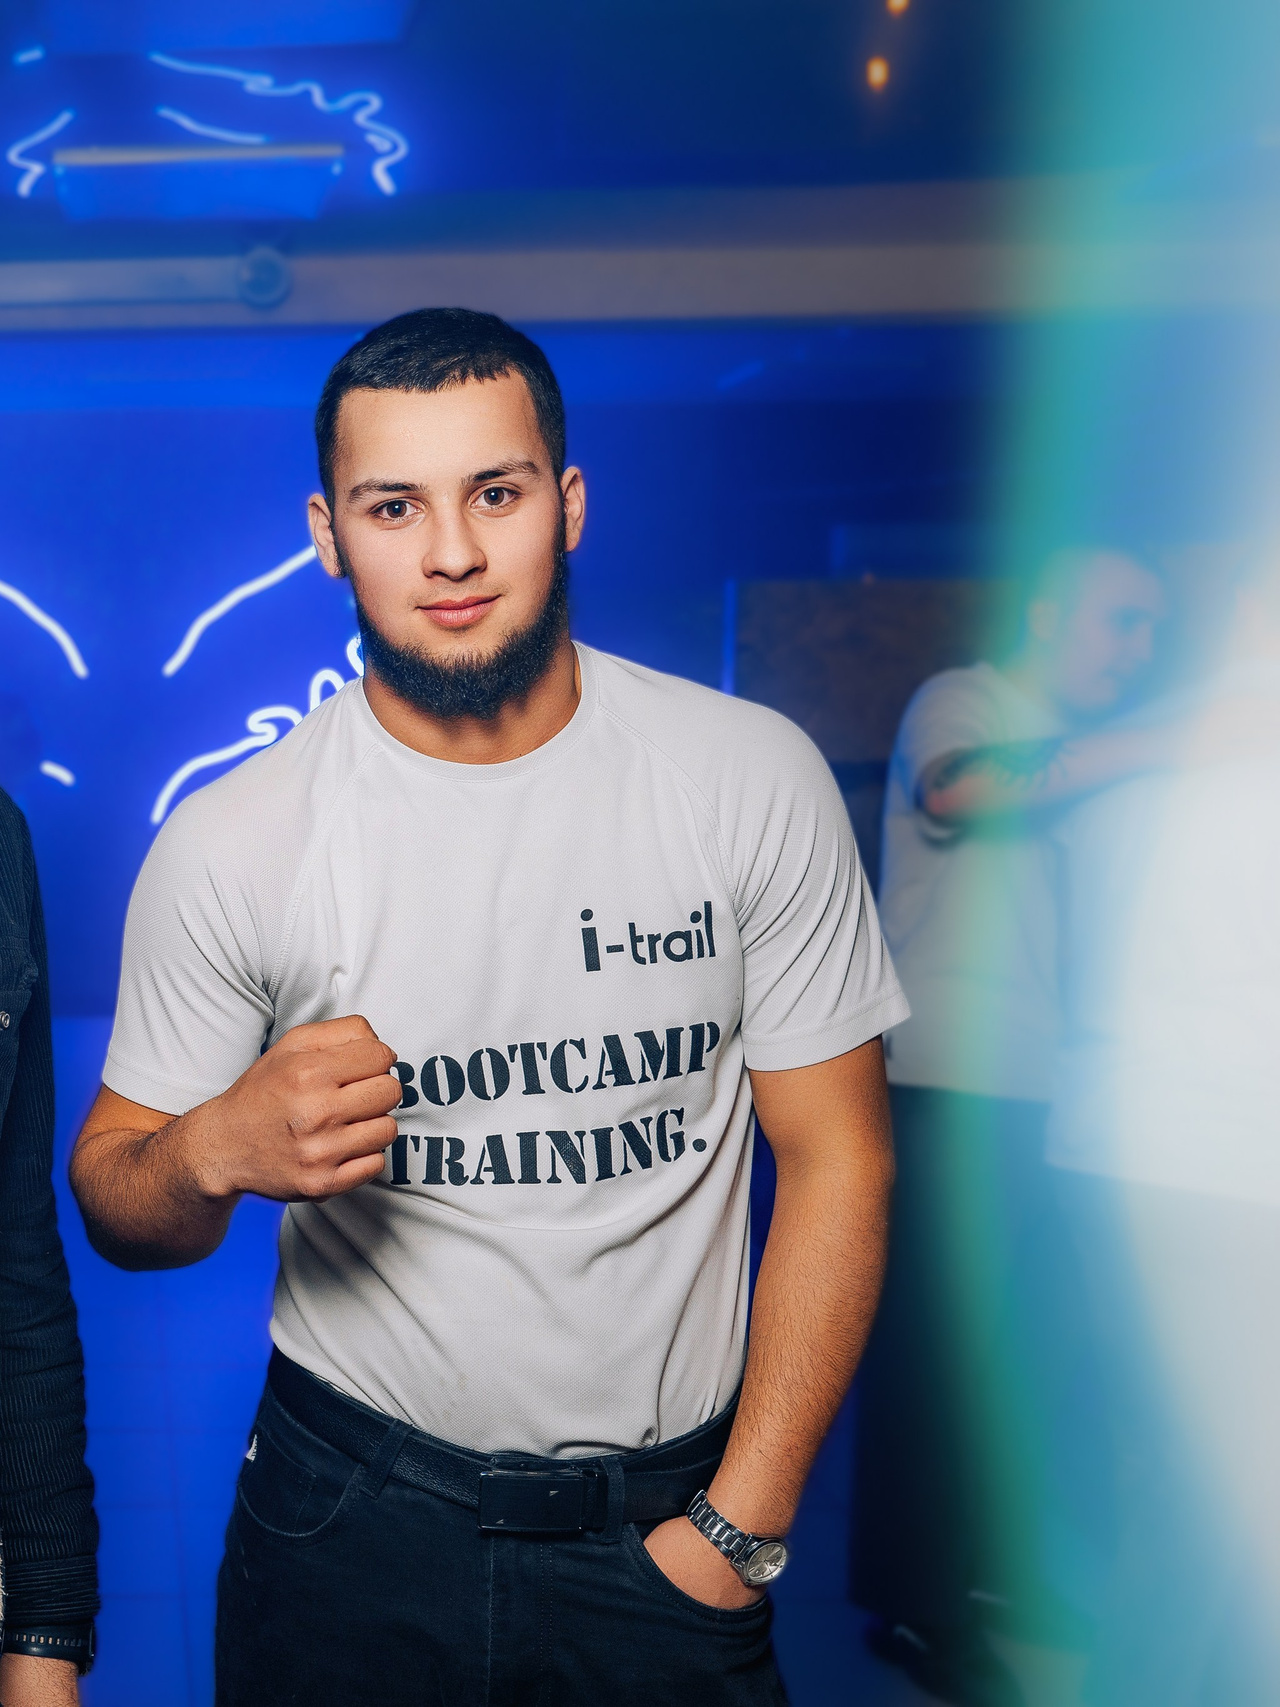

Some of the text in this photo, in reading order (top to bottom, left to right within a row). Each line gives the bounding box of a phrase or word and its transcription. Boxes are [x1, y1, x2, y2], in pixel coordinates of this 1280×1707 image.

[580, 900, 716, 972] i-trail
[389, 1021, 721, 1109] BOOTCAMP
[382, 1107, 708, 1186] TRAINING.
